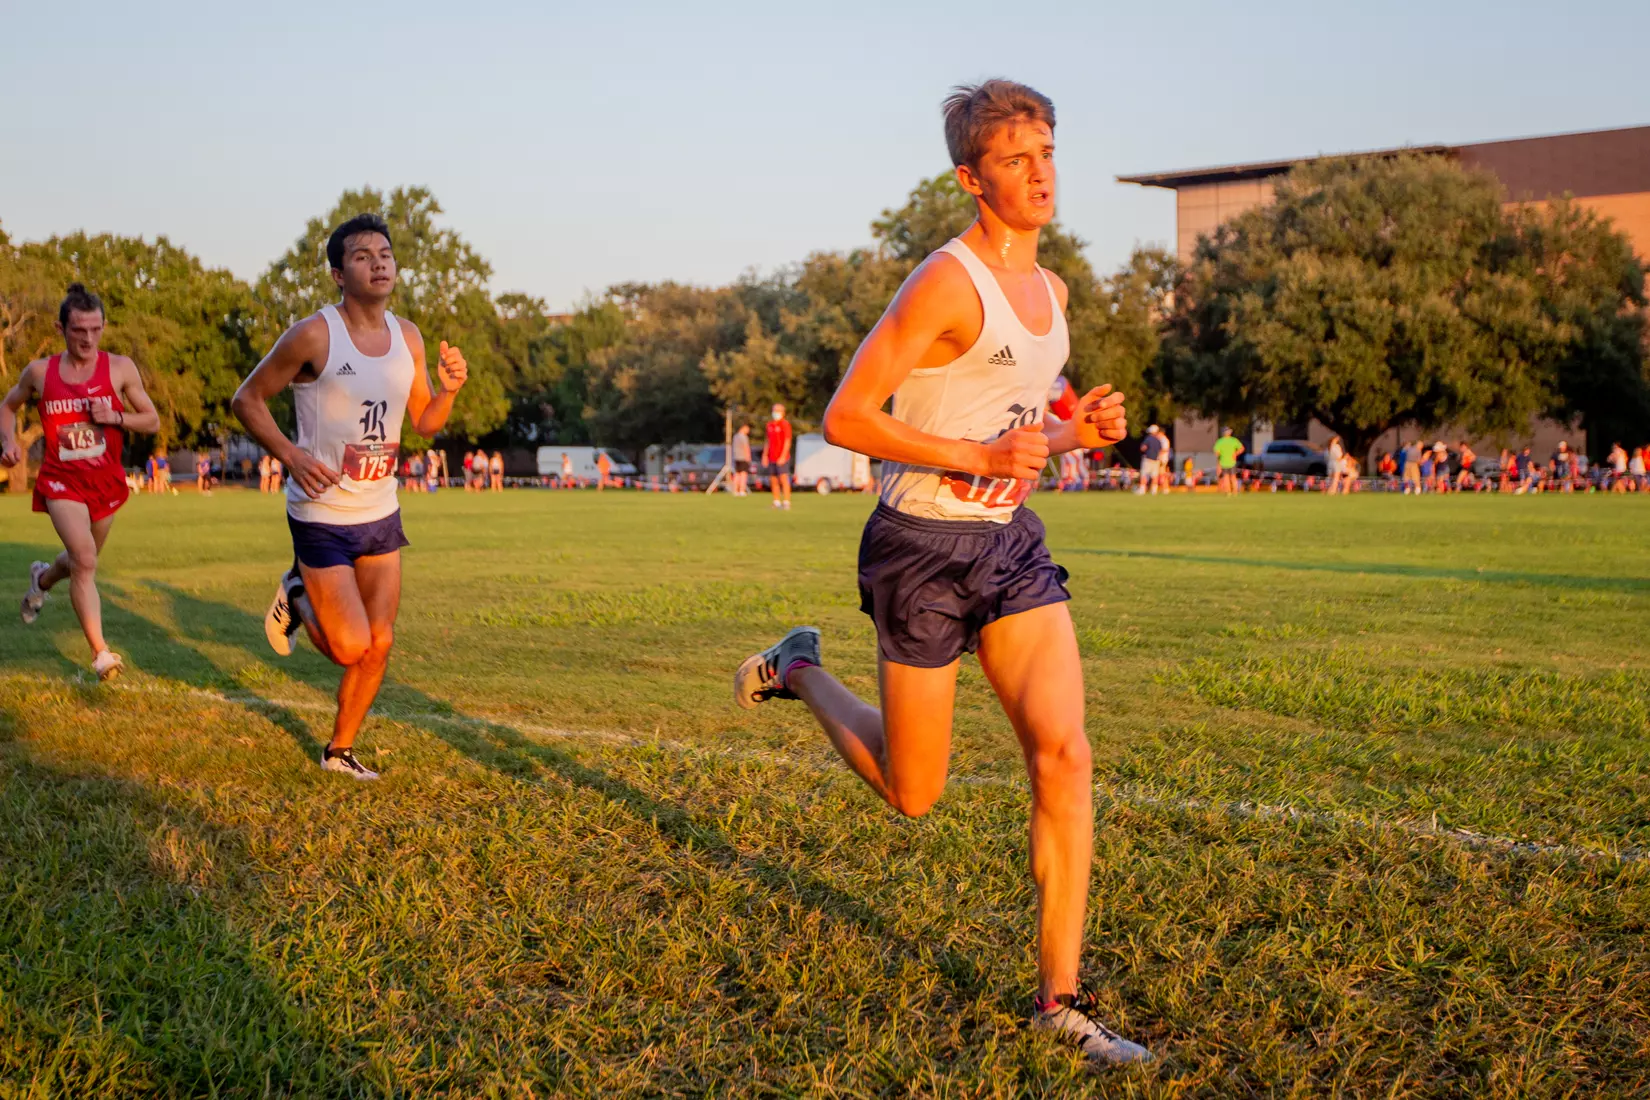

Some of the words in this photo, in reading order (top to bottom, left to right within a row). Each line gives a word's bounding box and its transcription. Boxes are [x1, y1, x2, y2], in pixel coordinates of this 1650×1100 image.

[45, 395, 112, 415] HOUSTN
[359, 400, 388, 442] R
[68, 429, 95, 450] 143
[358, 455, 389, 479] 175
